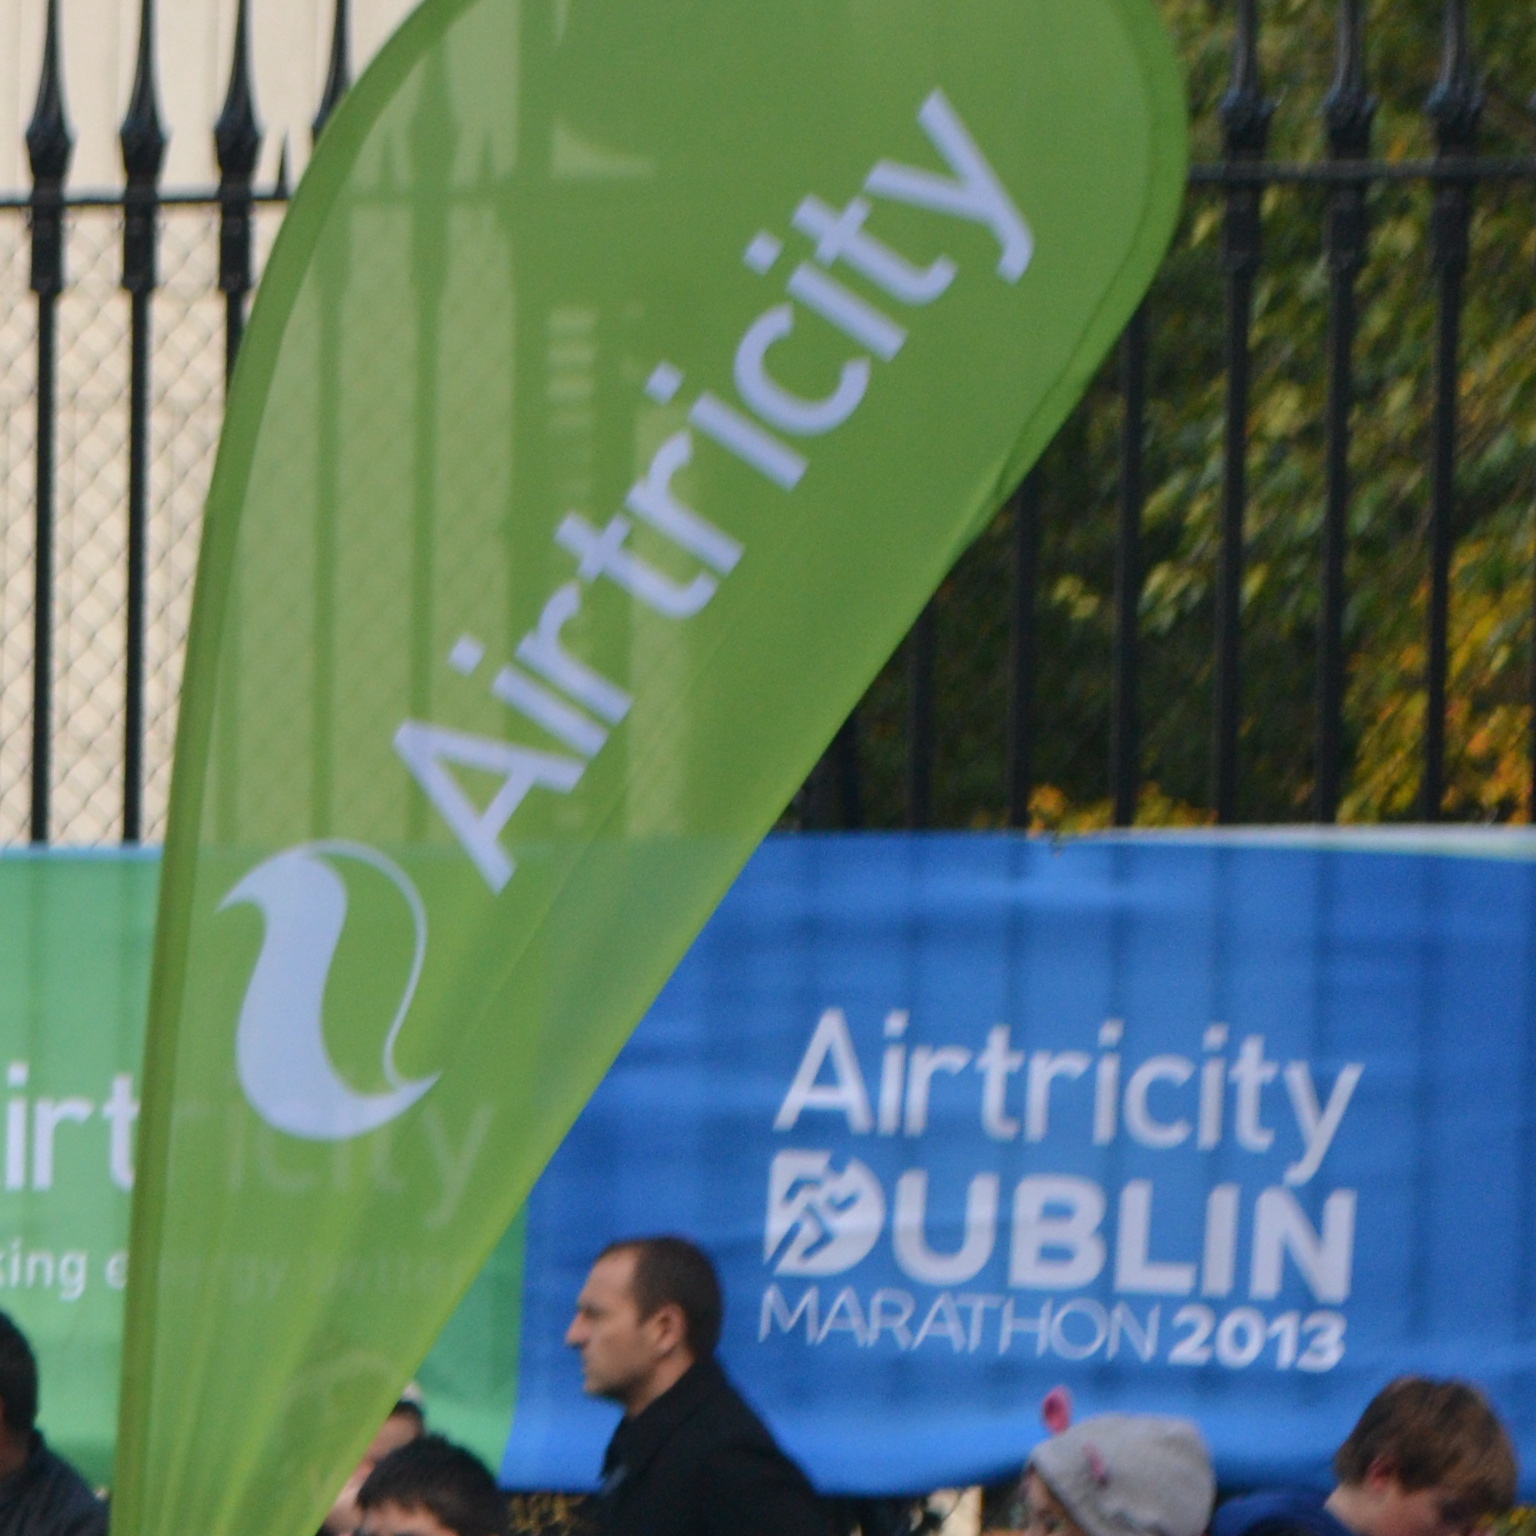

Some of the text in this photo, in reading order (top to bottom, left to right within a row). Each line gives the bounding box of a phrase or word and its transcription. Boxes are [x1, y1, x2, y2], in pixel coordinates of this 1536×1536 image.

[392, 86, 1035, 895] Airtricity
[773, 1006, 1365, 1186] Airtricity
[763, 1147, 1357, 1304] DUBLIN
[759, 1284, 1347, 1373] MARATHON 2013
